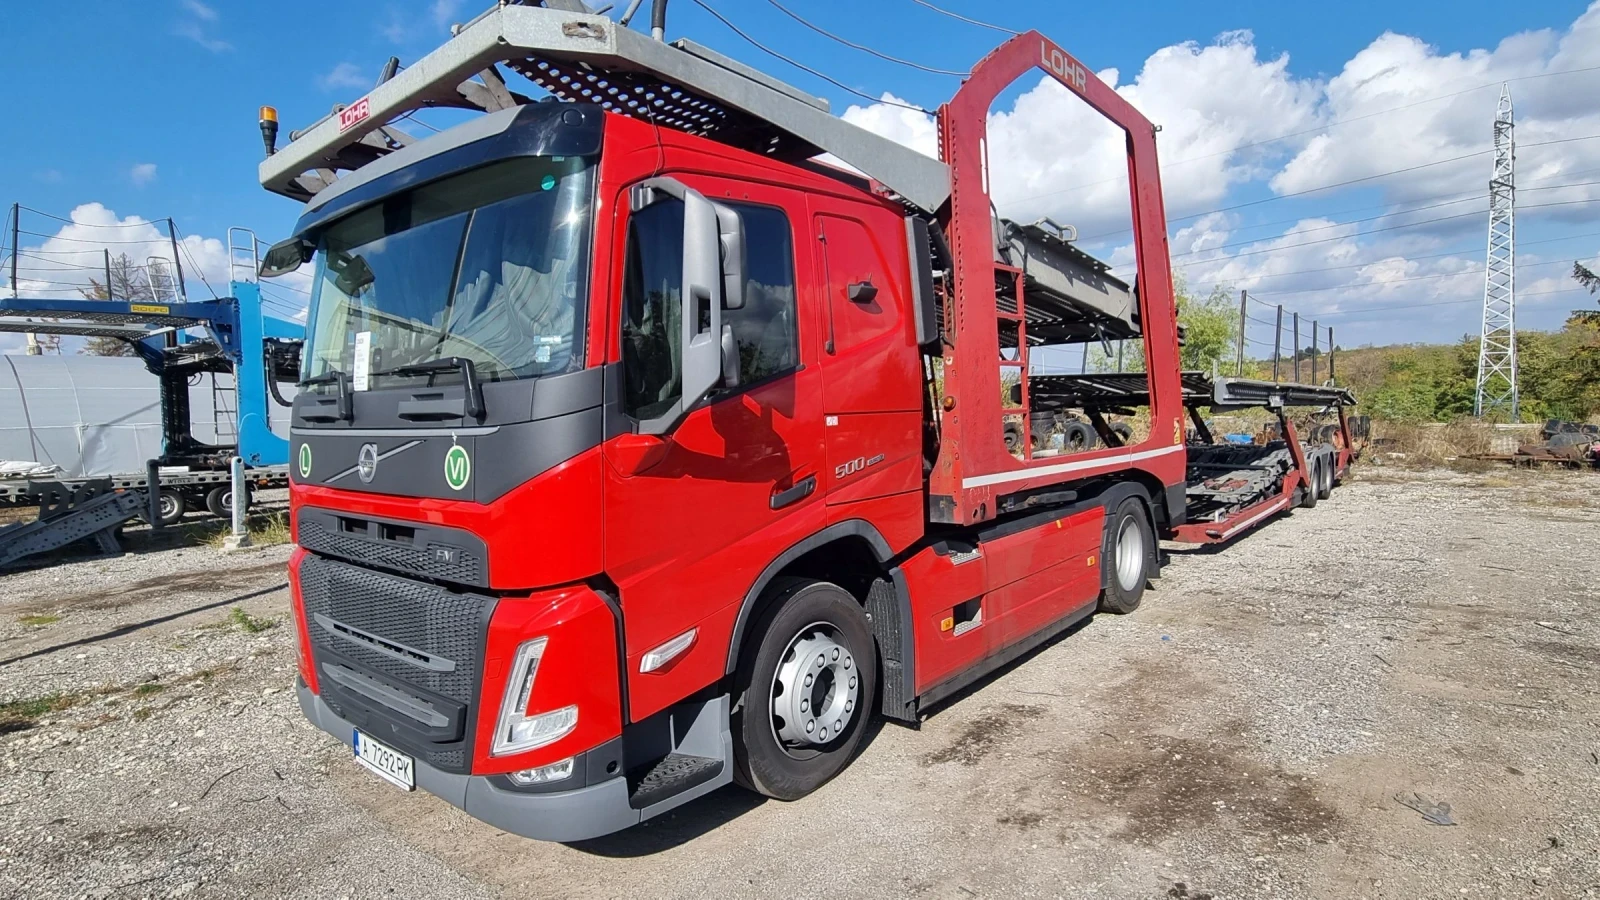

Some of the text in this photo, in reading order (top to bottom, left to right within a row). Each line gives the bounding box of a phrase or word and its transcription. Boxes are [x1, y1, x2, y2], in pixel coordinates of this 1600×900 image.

[1041, 40, 1086, 93] LOHR
[340, 99, 369, 130] LOHR
[302, 450, 308, 470] L
[449, 456, 464, 481] VI
[835, 456, 865, 479] 500
[436, 549, 454, 562] FM
[363, 739, 369, 758] A
